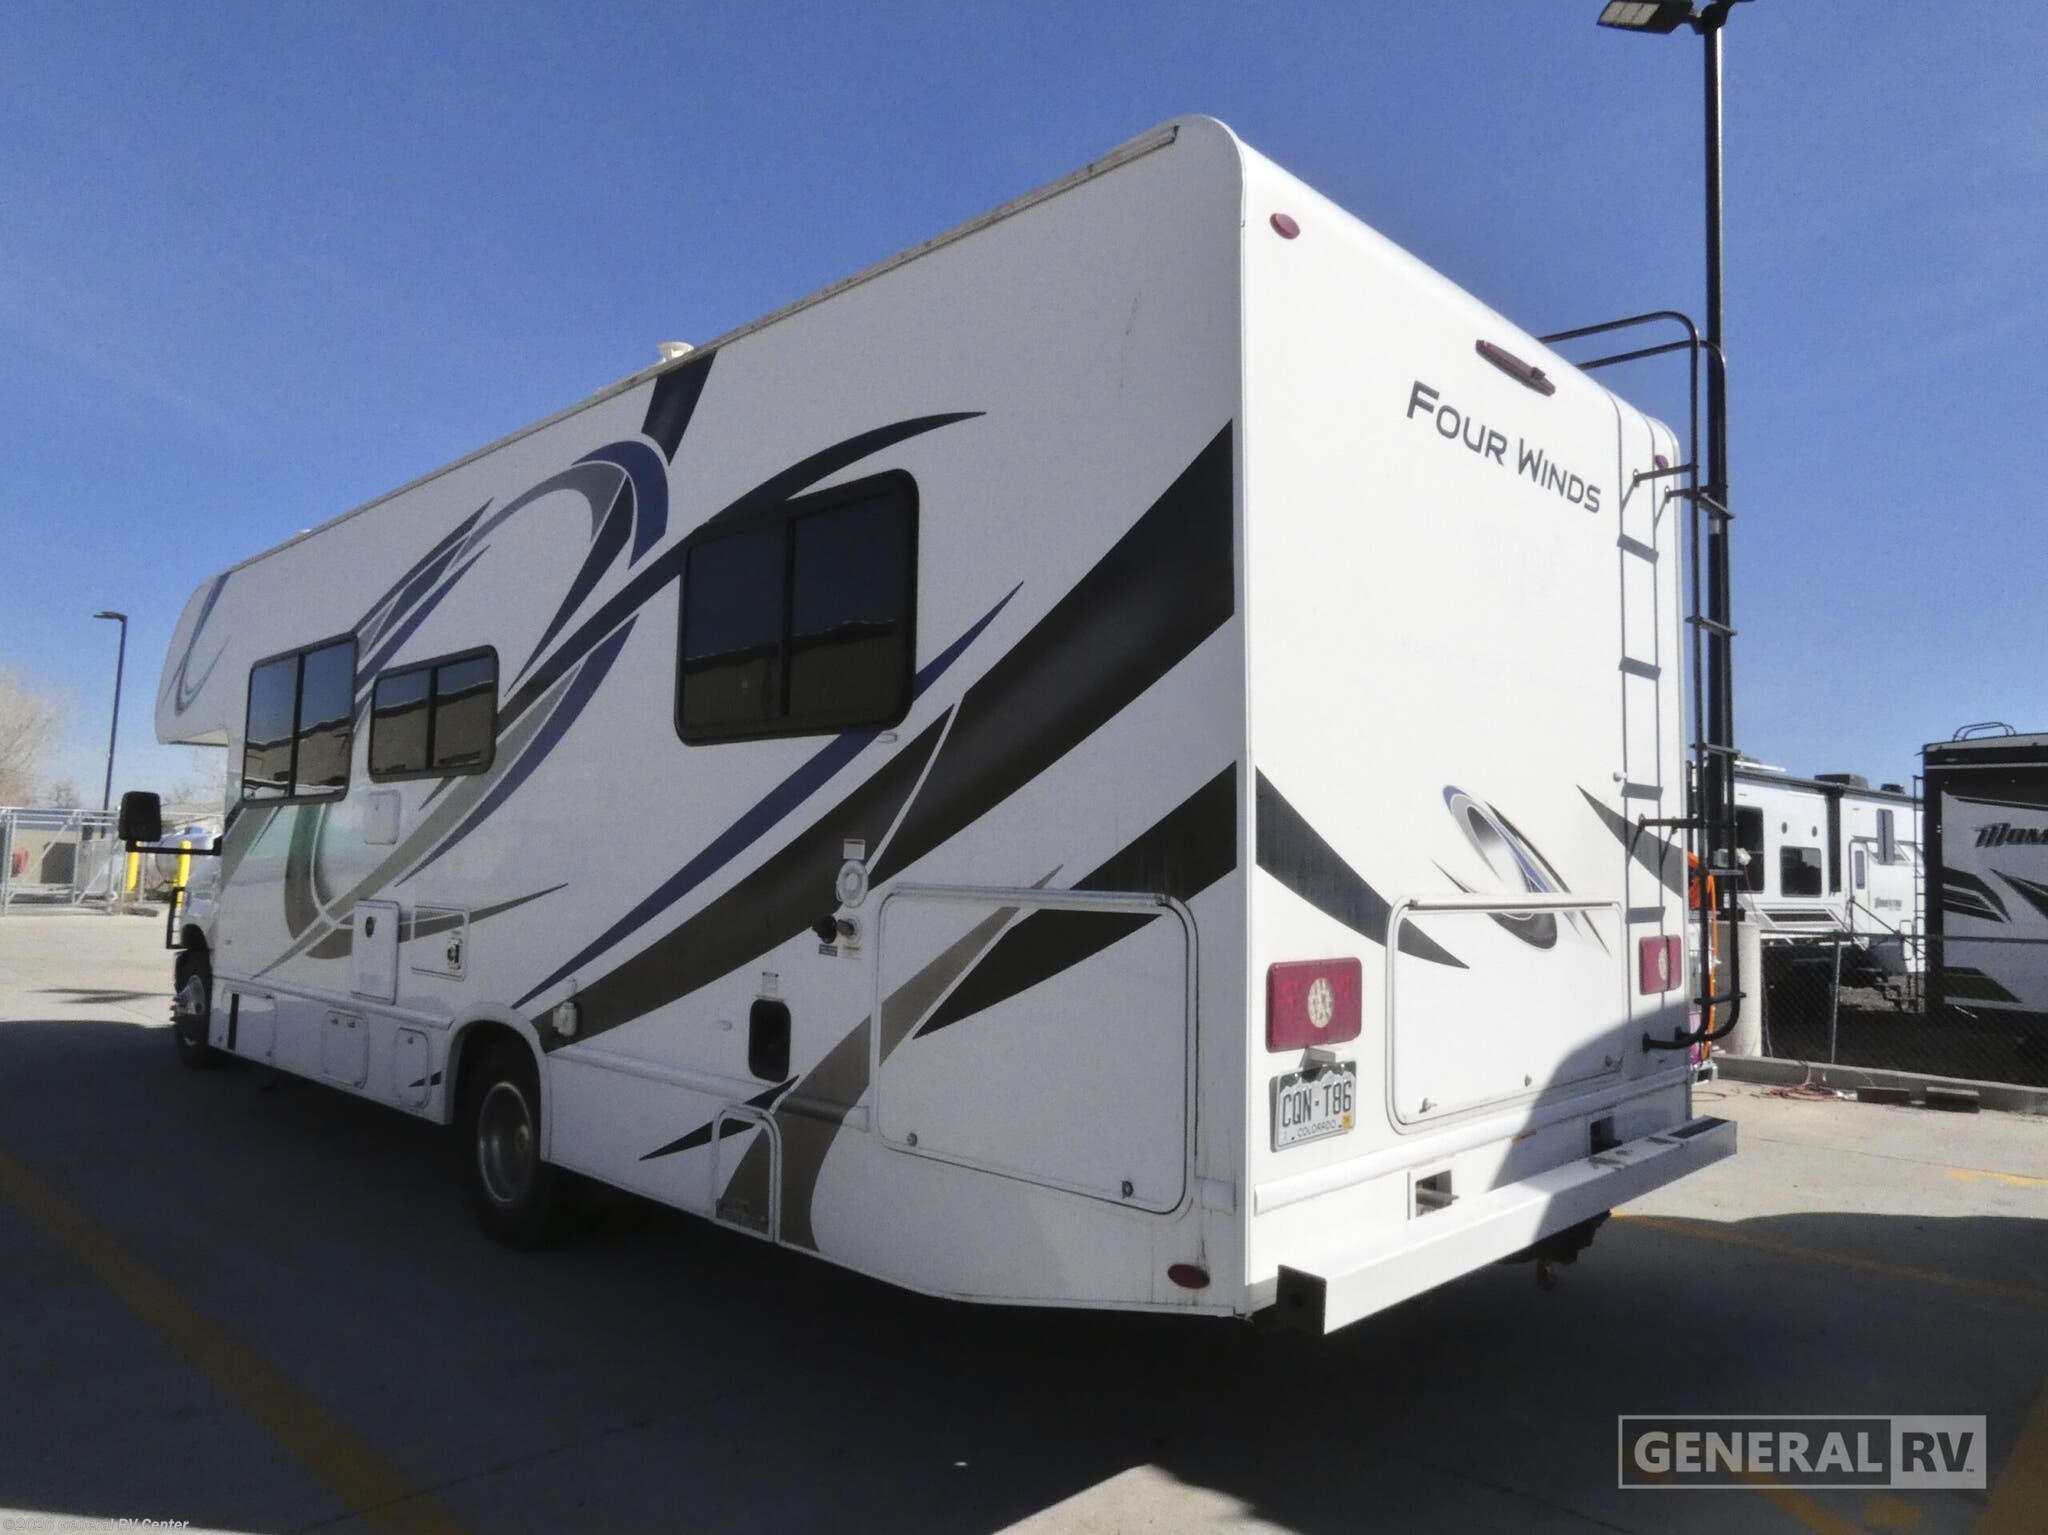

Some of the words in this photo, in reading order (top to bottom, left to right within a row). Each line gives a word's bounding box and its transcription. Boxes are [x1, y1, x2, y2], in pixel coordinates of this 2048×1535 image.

[1406, 380, 1507, 466] FOUR
[1518, 437, 1601, 514] WINDS
[1297, 1119, 1337, 1138] COLORADO
